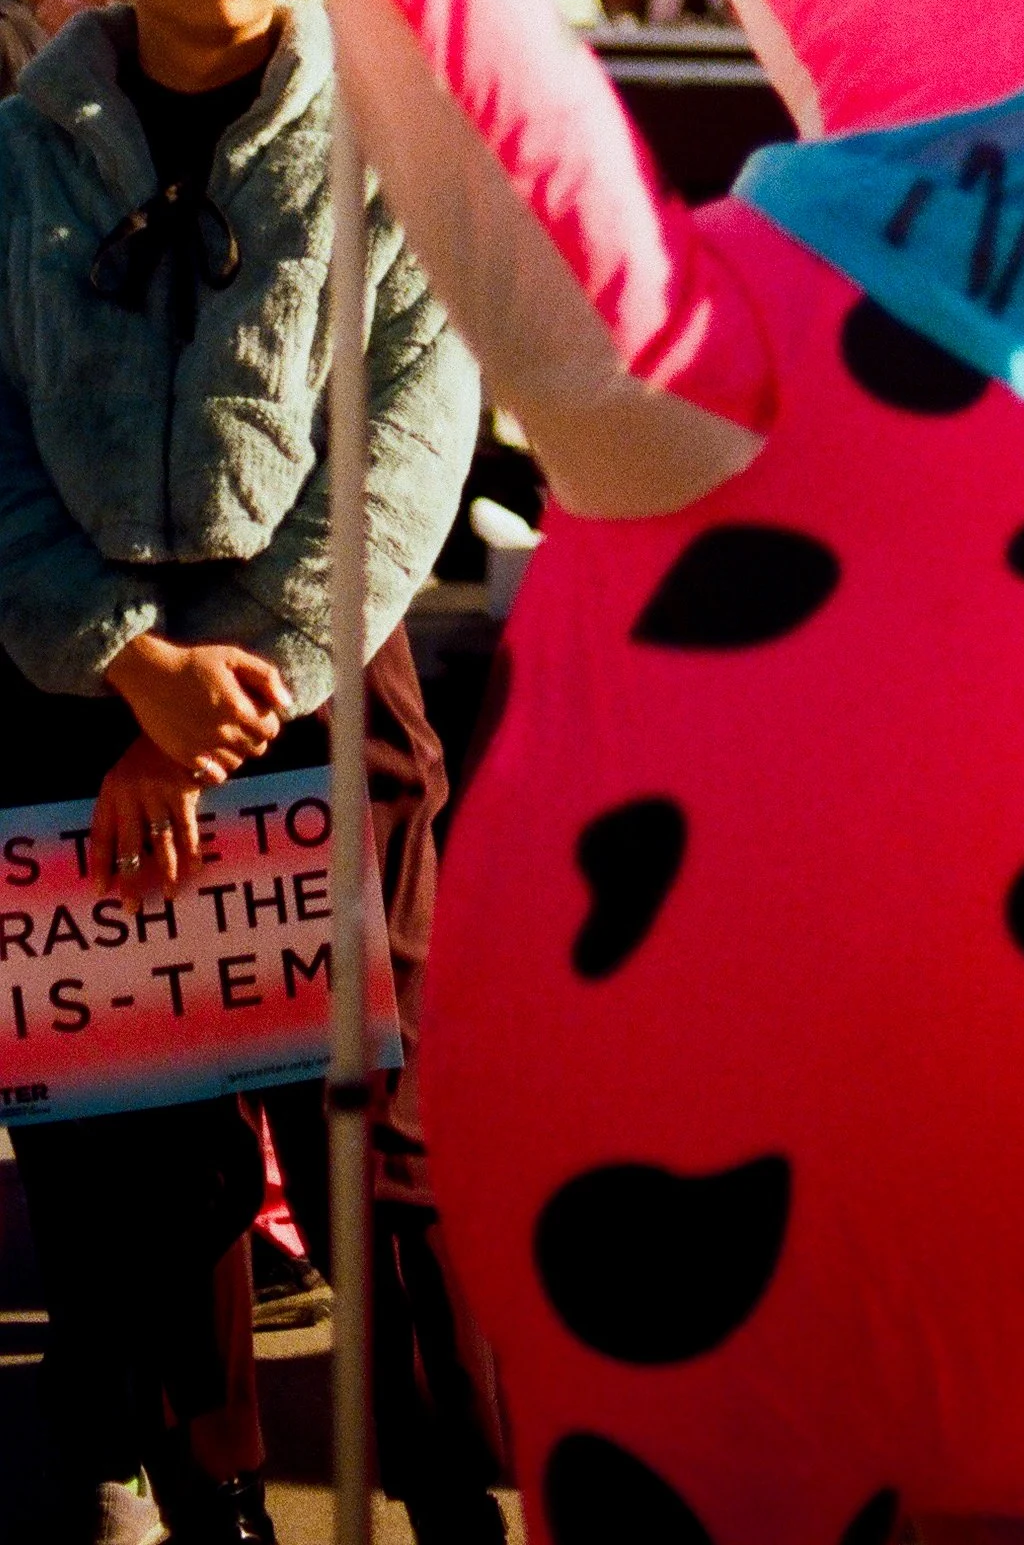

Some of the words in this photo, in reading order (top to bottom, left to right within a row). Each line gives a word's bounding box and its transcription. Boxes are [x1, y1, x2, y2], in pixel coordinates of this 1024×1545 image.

[240, 797, 332, 854] TO
[0, 898, 178, 960] RASH
[199, 869, 332, 933] THE
